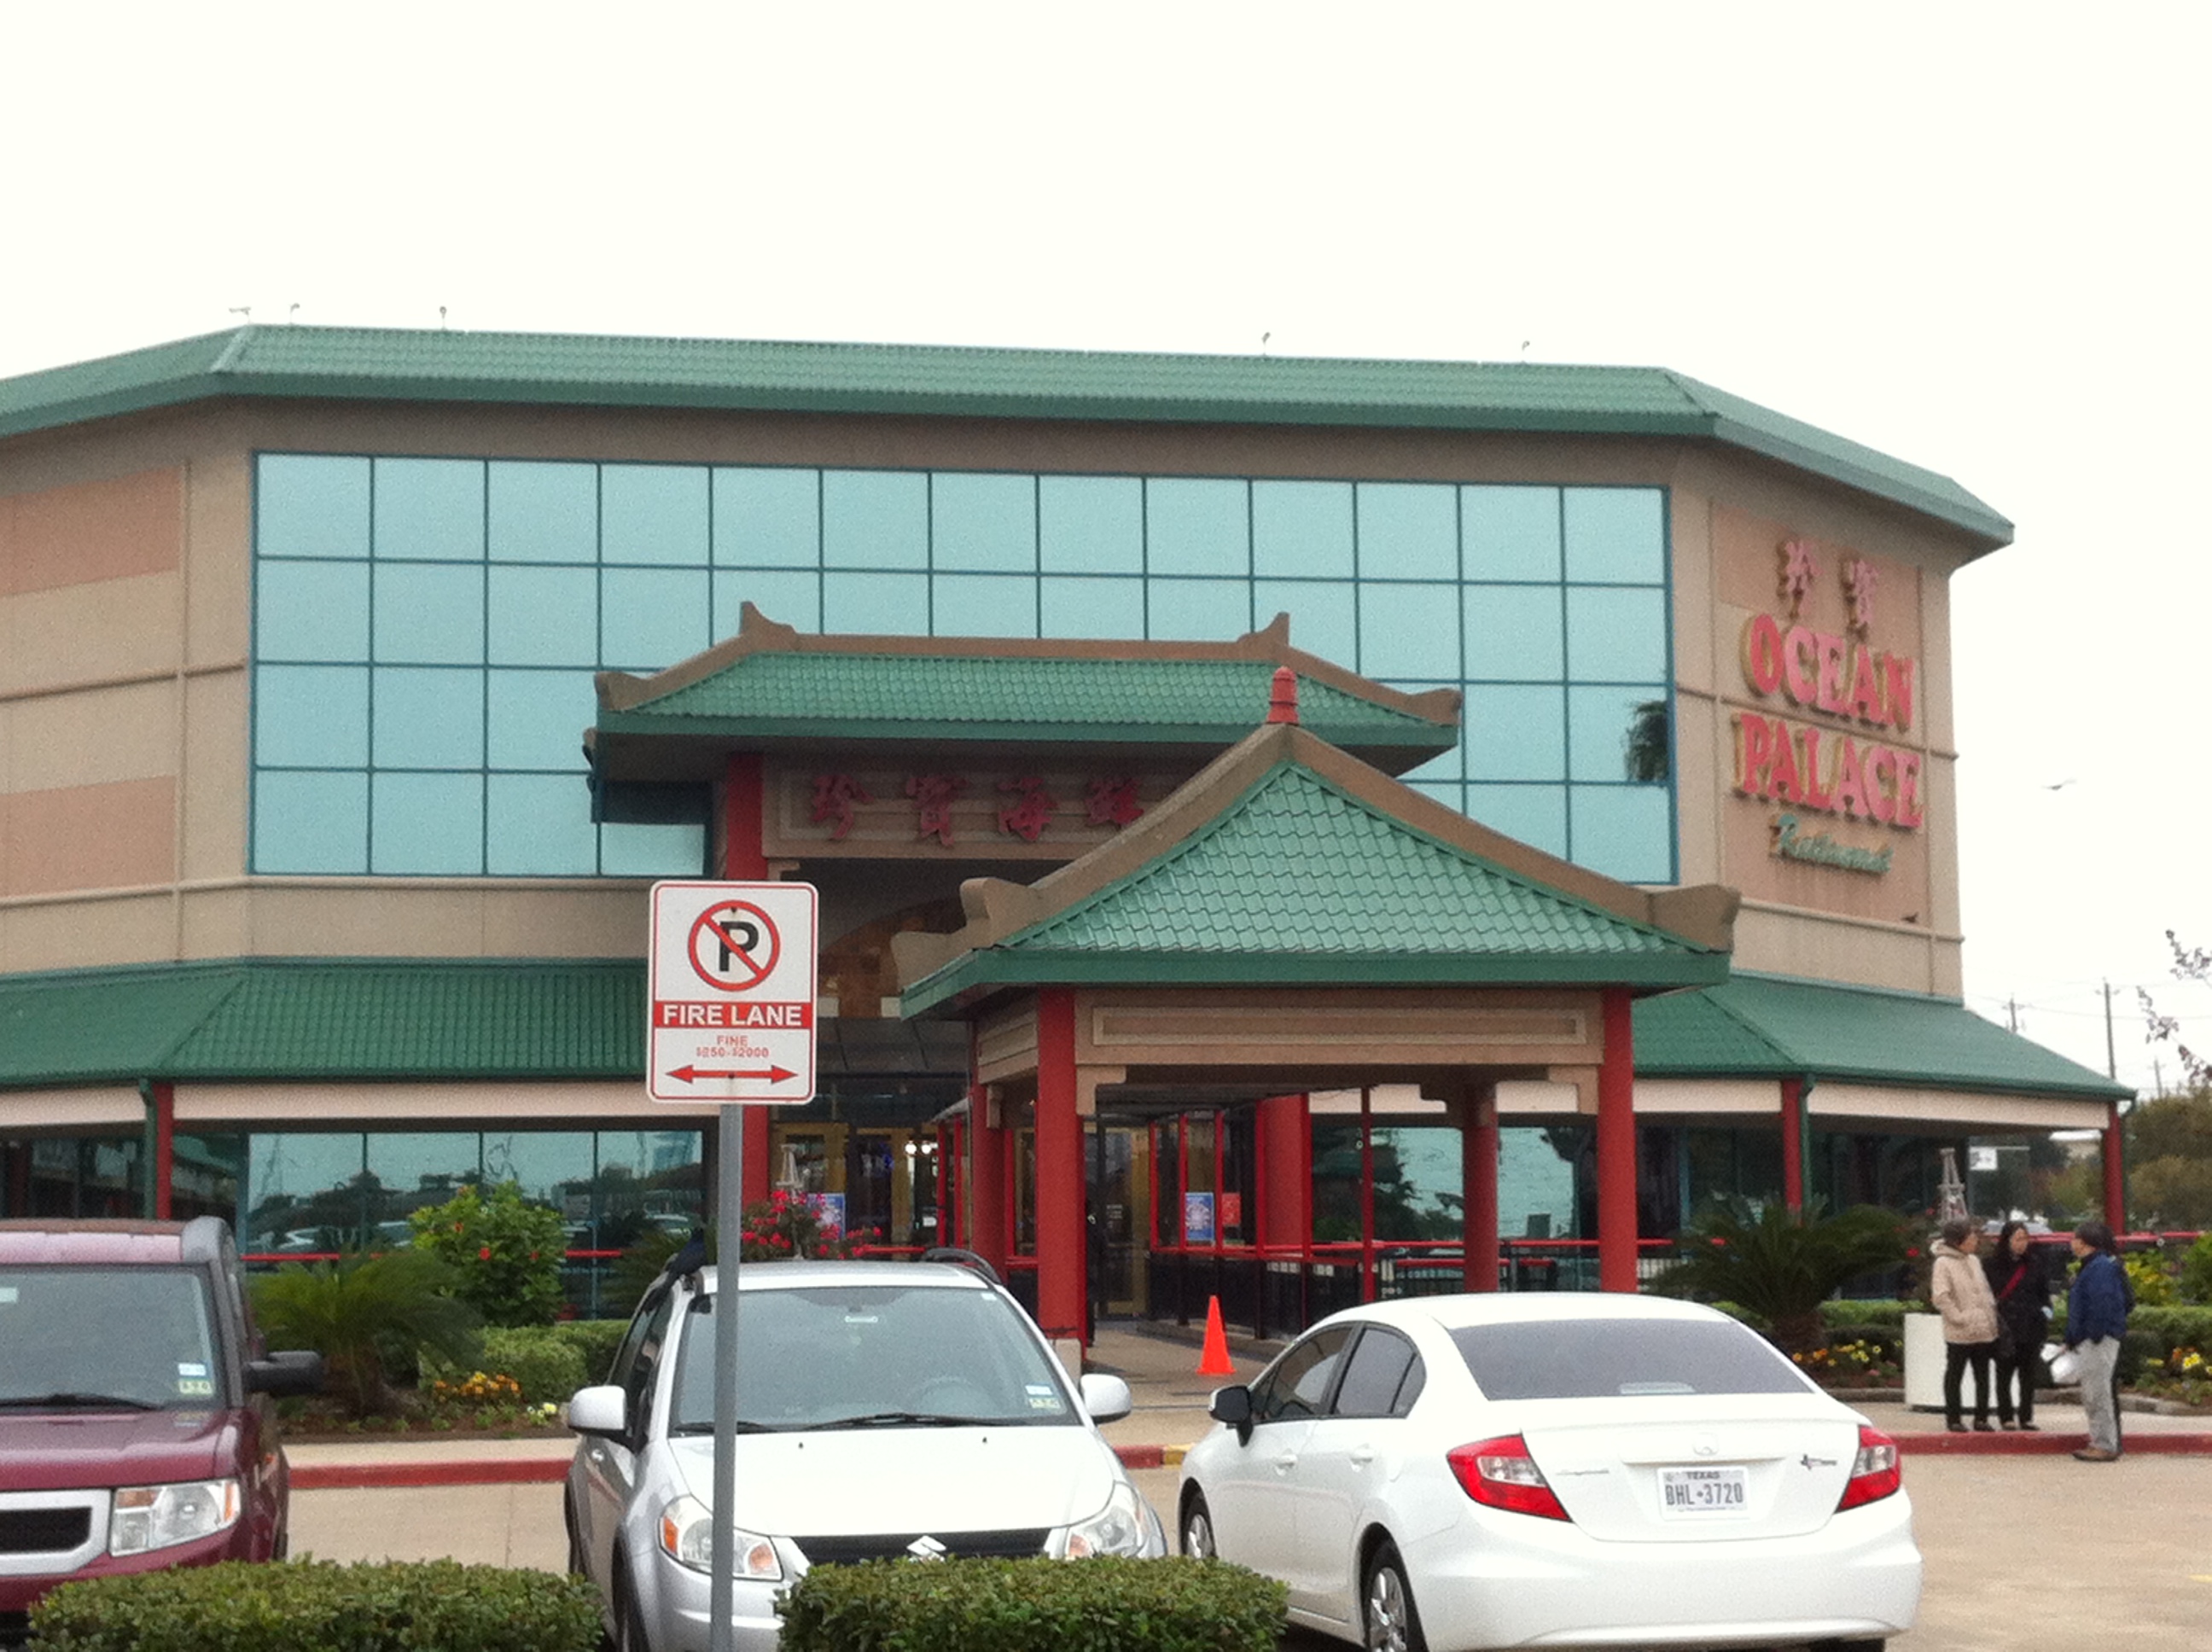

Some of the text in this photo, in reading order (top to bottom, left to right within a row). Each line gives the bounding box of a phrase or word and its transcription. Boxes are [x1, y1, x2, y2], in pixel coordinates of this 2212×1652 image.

[1743, 613, 1916, 731] OCEAN
[1736, 713, 1924, 829] PALACE
[719, 921, 760, 972] P
[663, 1004, 802, 1026] FIRE LANE
[717, 1035, 748, 1046] FINE
[1685, 1471, 1720, 1480] TEXAS
